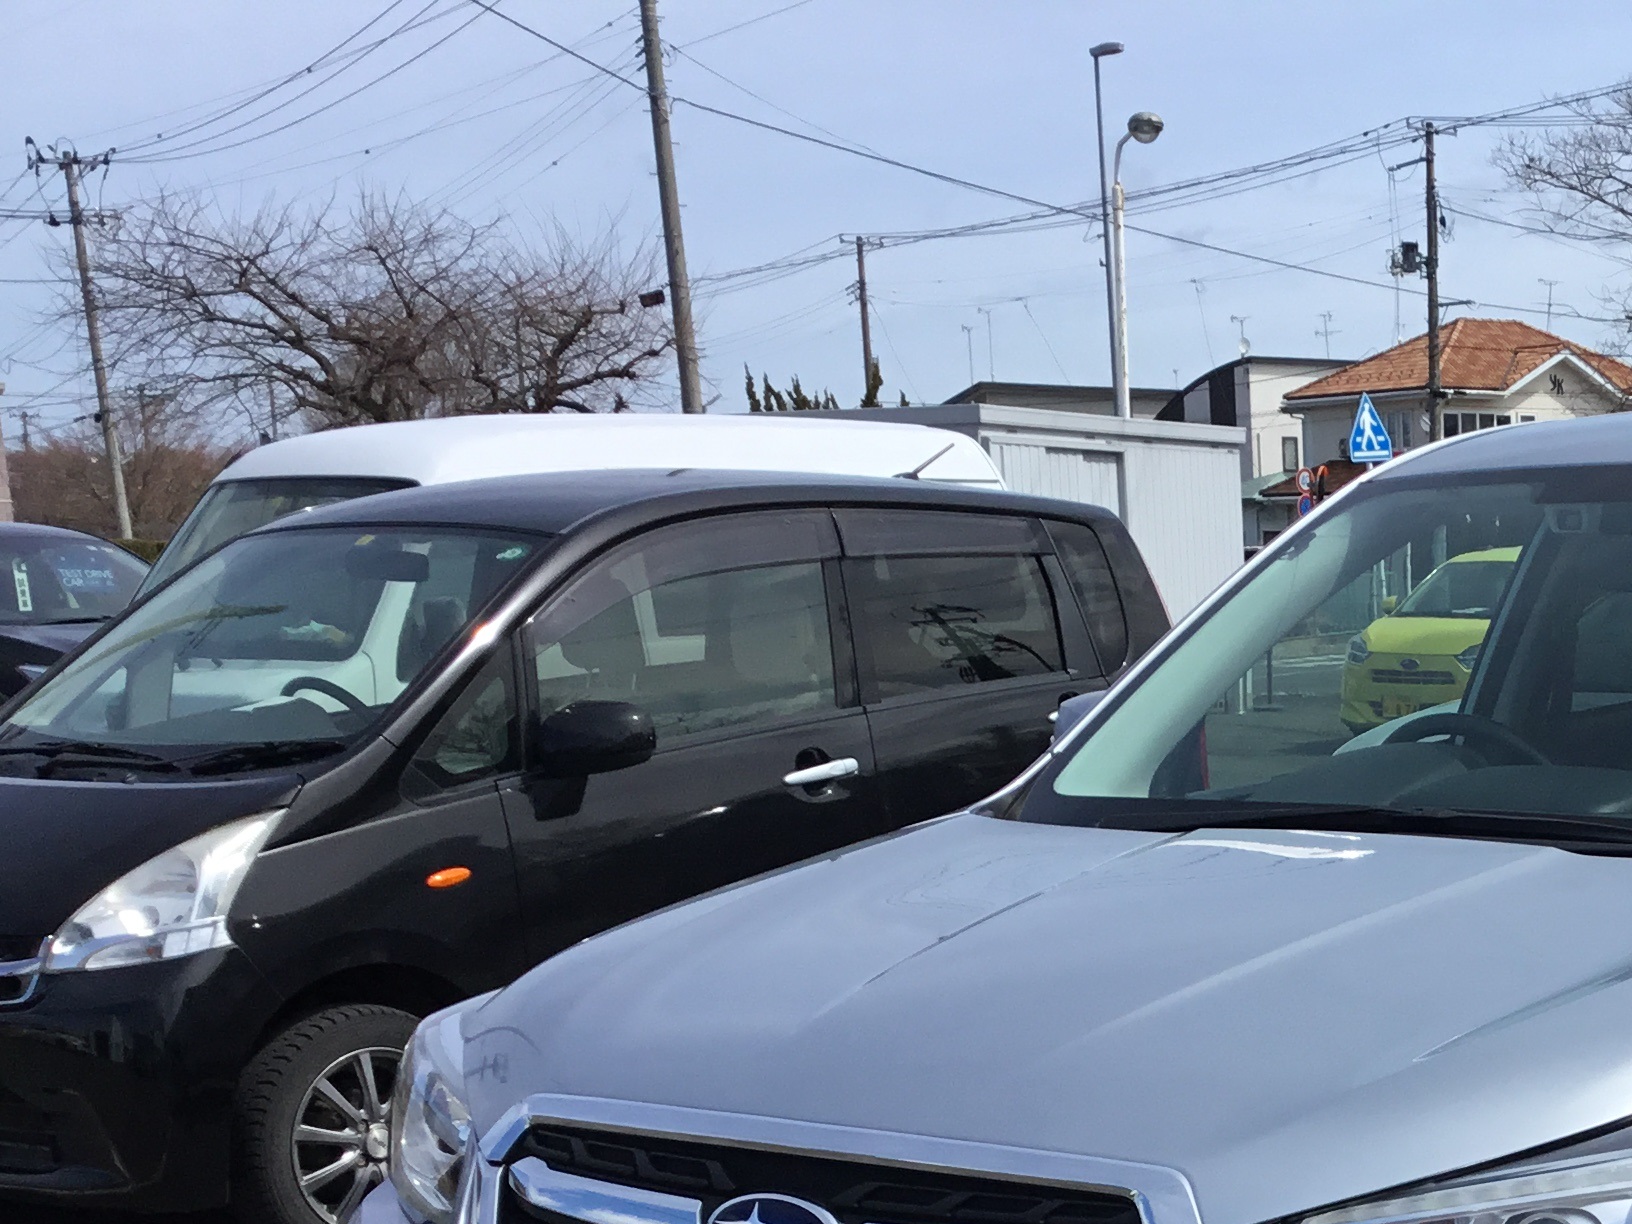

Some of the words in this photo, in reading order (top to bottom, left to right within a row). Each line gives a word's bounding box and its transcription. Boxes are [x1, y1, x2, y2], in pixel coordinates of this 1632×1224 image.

[58, 568, 83, 578] TEST
[84, 569, 114, 579] DRIVE
[62, 577, 84, 587] CAR
